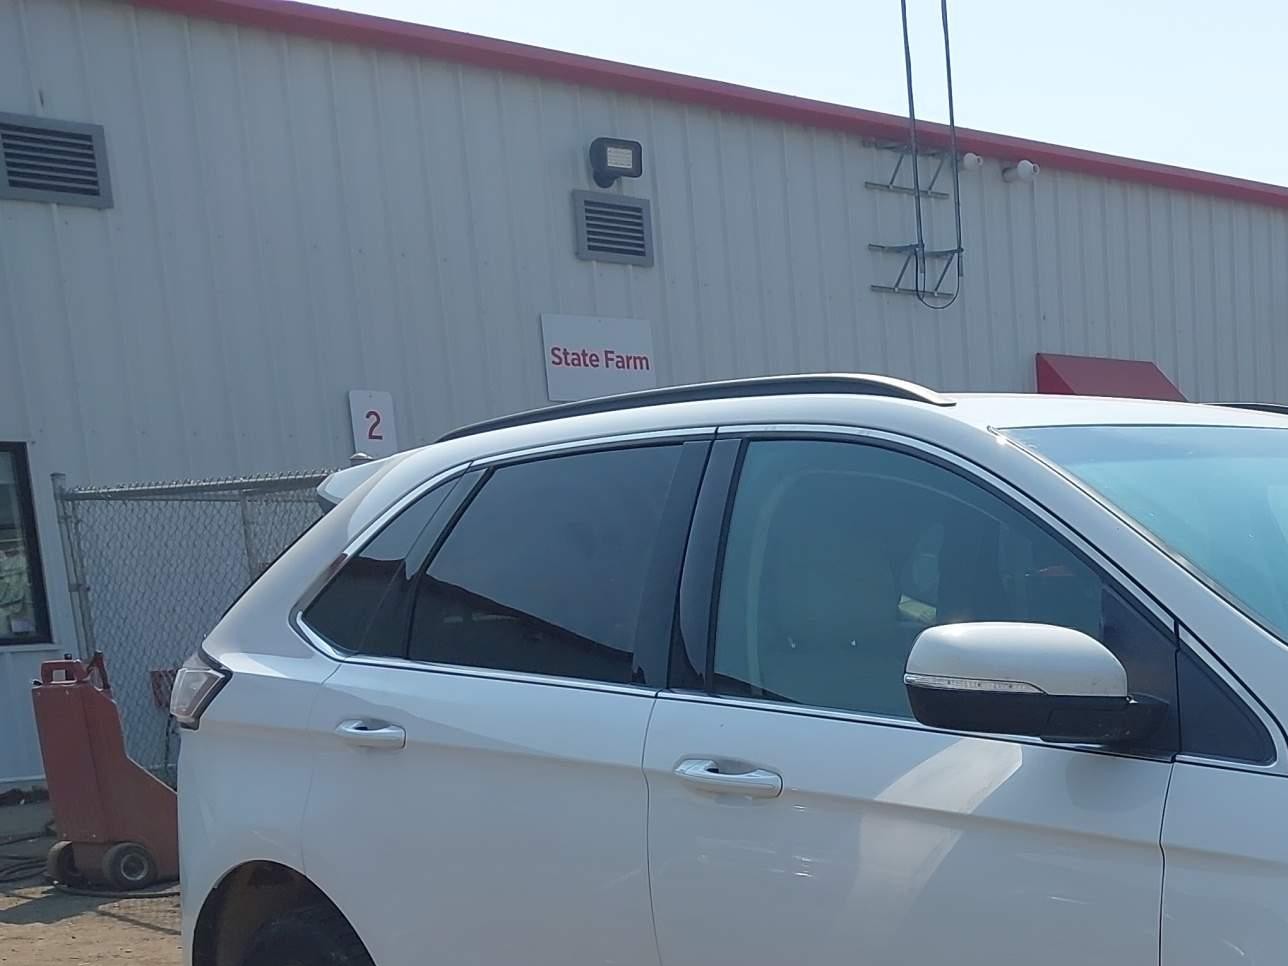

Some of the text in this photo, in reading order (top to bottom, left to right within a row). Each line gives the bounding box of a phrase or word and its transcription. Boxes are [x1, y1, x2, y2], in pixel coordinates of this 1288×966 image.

[550, 346, 650, 371] State Farm
[364, 410, 383, 441] 2
